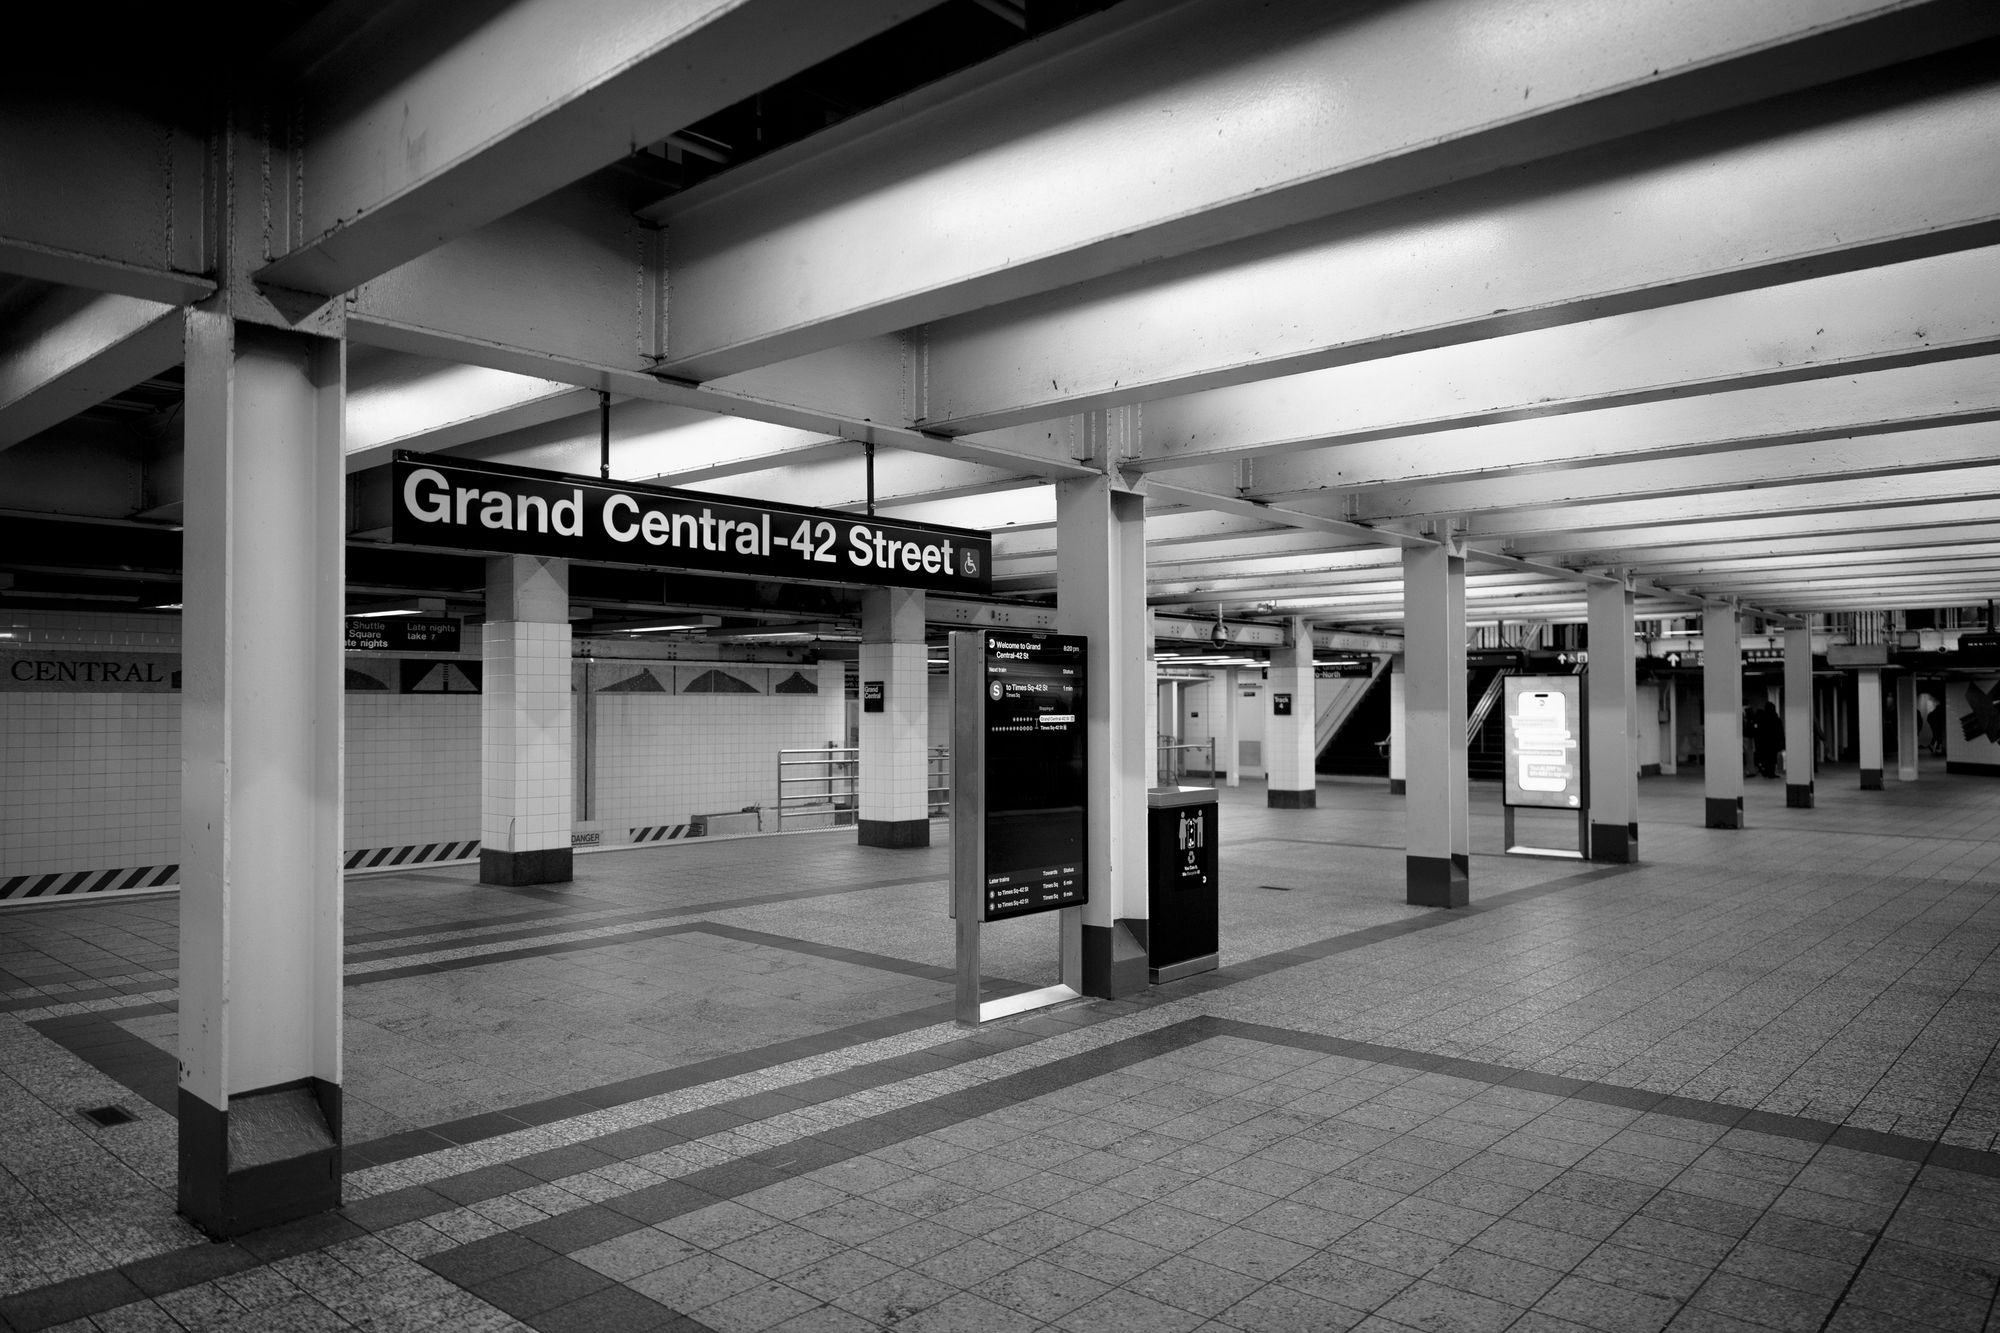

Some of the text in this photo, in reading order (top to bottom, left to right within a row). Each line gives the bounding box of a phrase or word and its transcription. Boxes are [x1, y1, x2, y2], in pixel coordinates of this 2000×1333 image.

[403, 468, 954, 575] Grand Central-42 Street
[353, 621, 386, 630] Shuttle
[407, 623, 456, 633] Late nights
[349, 629, 382, 640] Square
[407, 632, 427, 640] take
[360, 639, 388, 648] nights
[996, 641, 1019, 649] Welcome
[996, 651, 1022, 659] Central-42
[10, 660, 164, 682] CENTRAL
[993, 685, 1000, 696] S
[1028, 684, 1042, 692] Sq-42
[571, 834, 599, 842] DANGER
